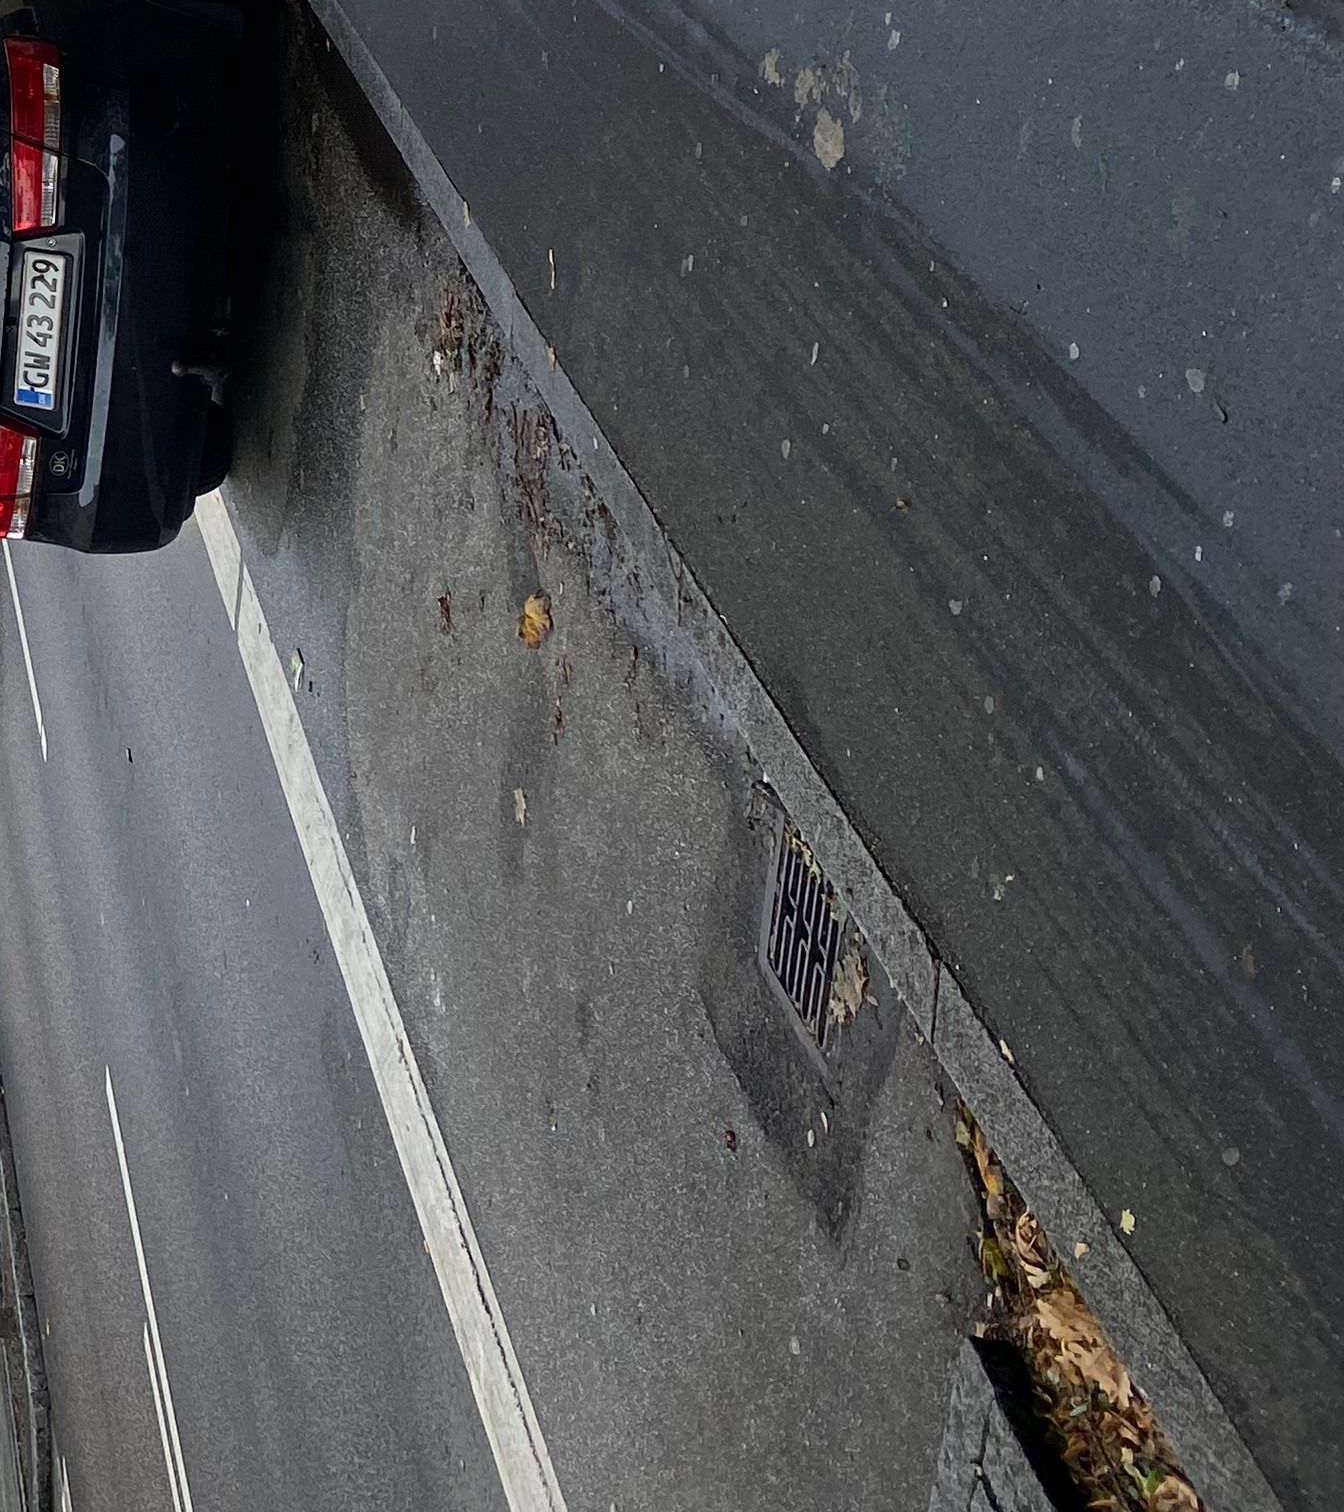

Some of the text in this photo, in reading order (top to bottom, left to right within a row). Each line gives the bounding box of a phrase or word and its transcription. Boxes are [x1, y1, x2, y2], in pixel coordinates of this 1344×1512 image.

[22, 258, 60, 389] GW 43 229
[52, 455, 66, 473] DK
